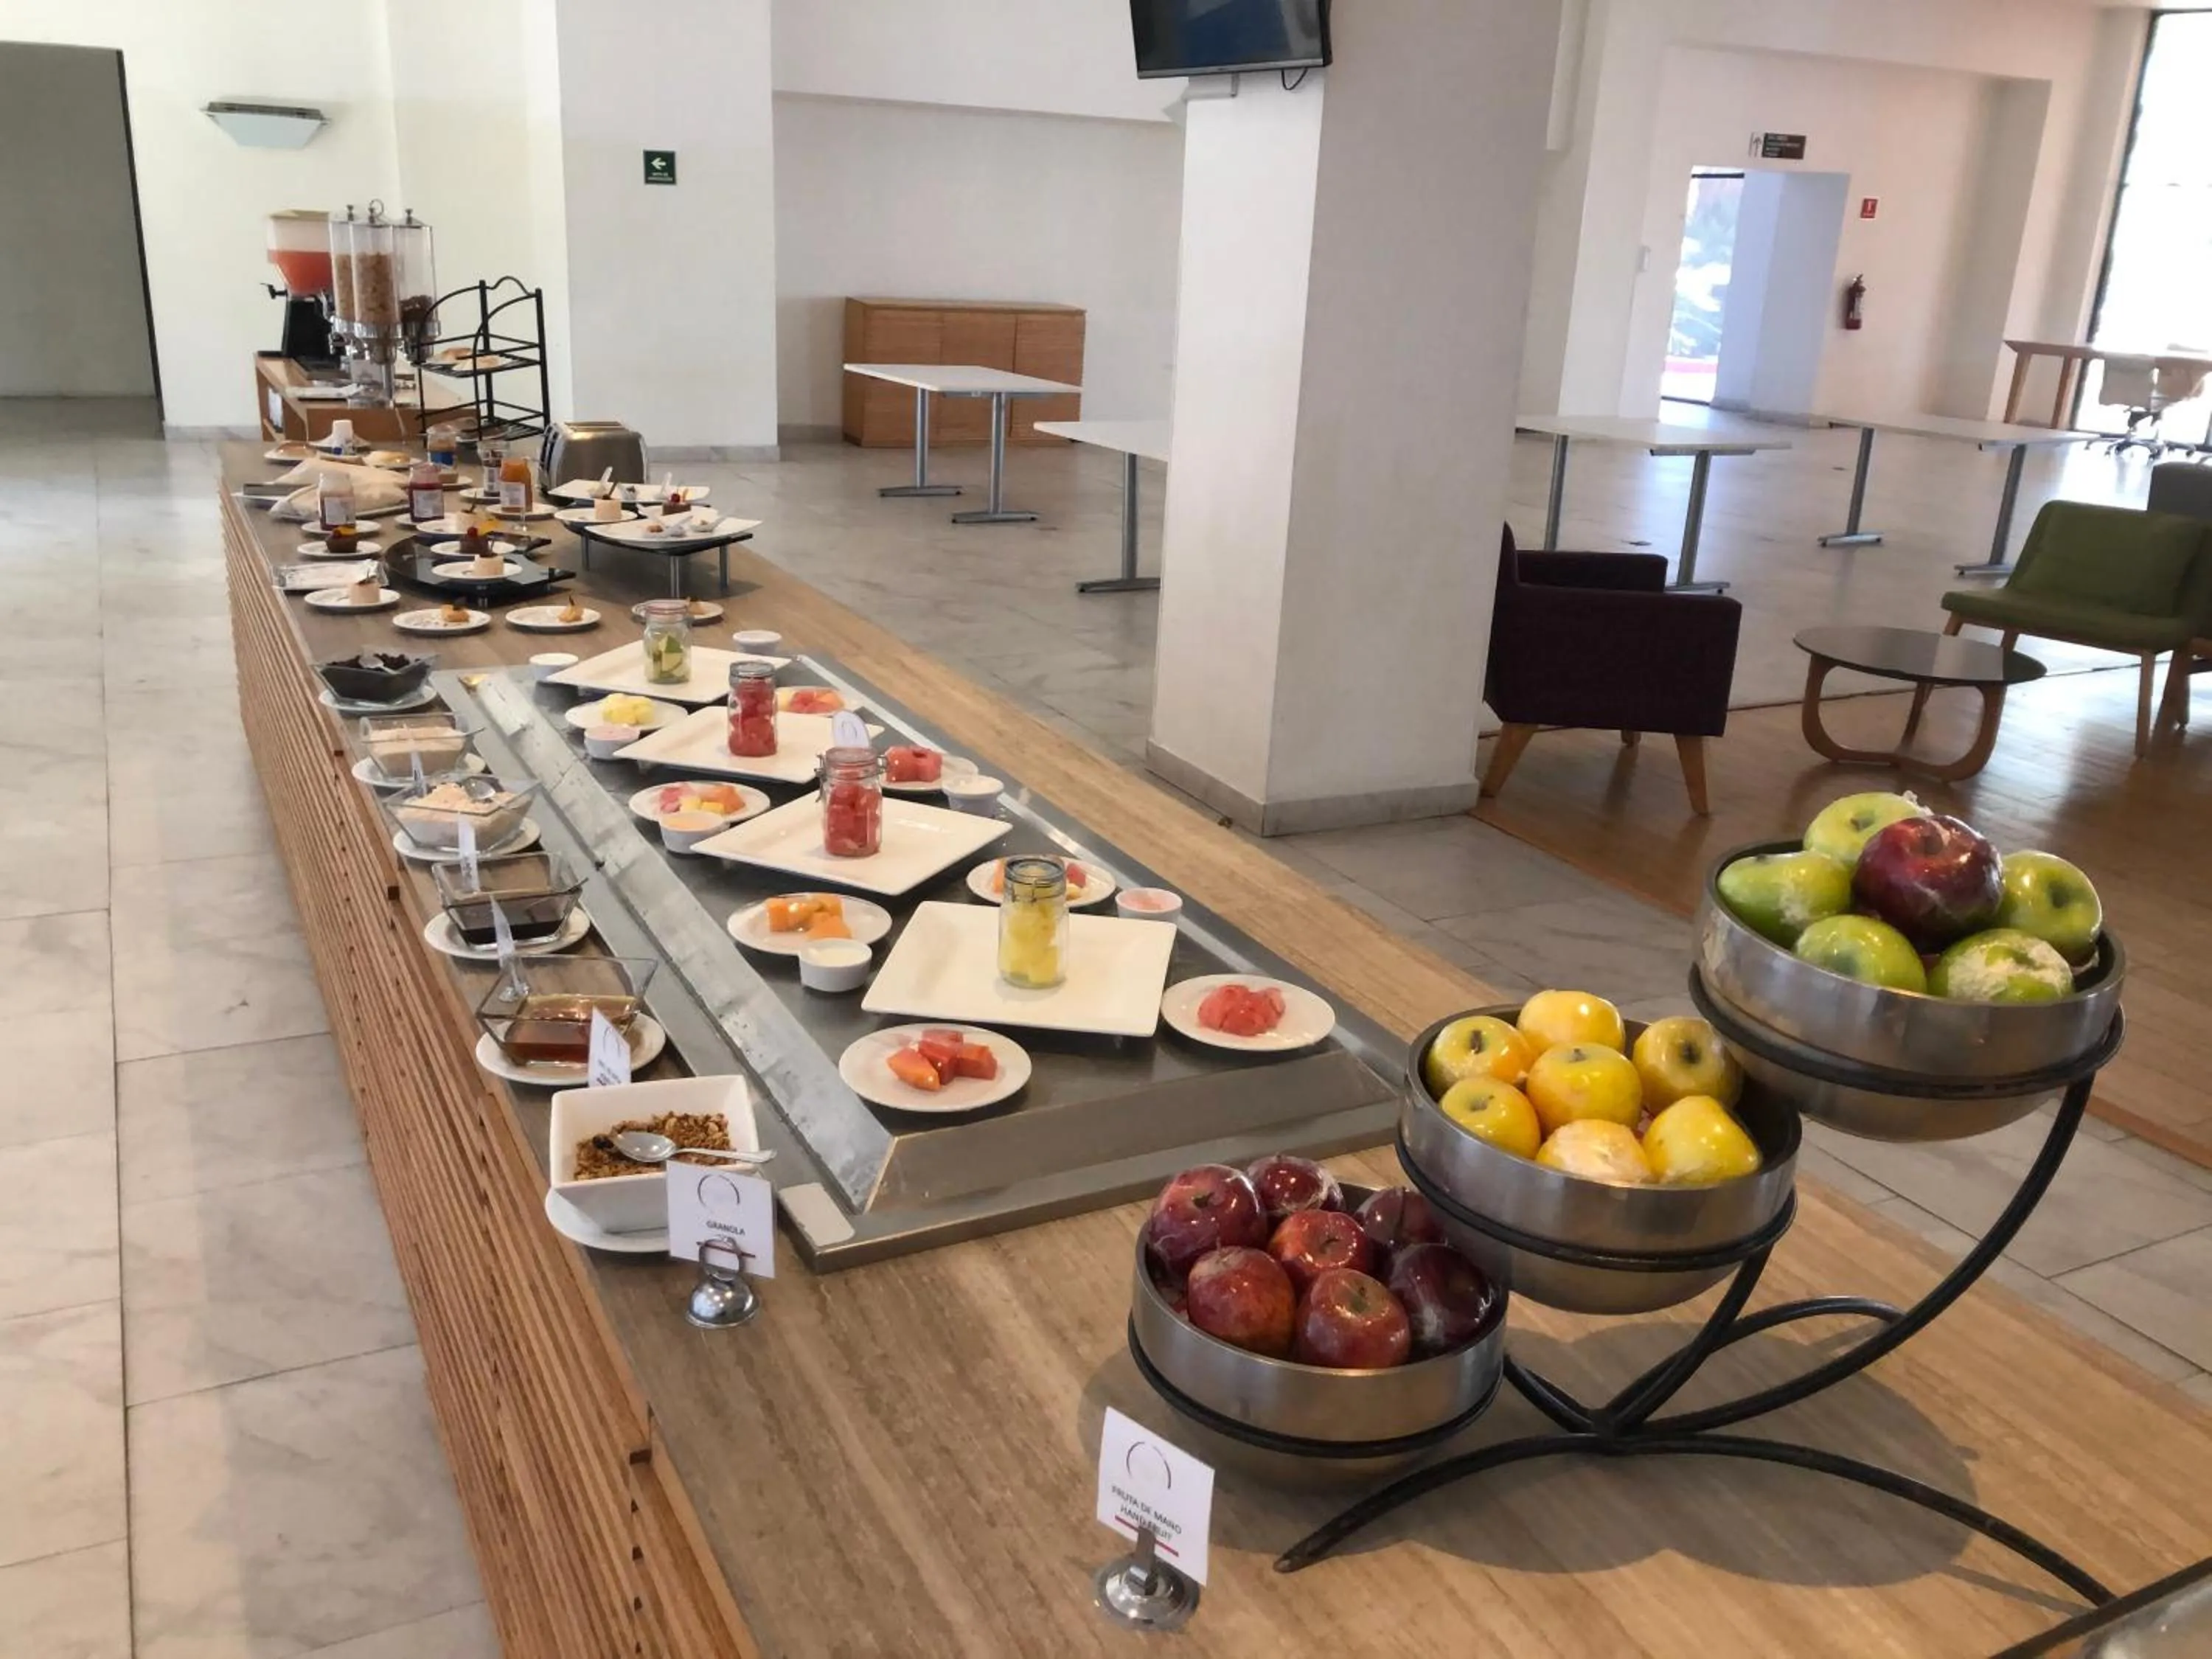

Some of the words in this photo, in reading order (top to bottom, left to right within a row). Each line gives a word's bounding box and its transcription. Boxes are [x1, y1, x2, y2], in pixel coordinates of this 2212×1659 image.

[706, 1220, 745, 1236] GRANOLA
[1111, 1485, 1139, 1509] FRUTA
[1141, 1501, 1151, 1514] DE
[1153, 1511, 1182, 1534] MANO
[1120, 1504, 1147, 1526] HAND
[1147, 1521, 1172, 1540] FRUIT
